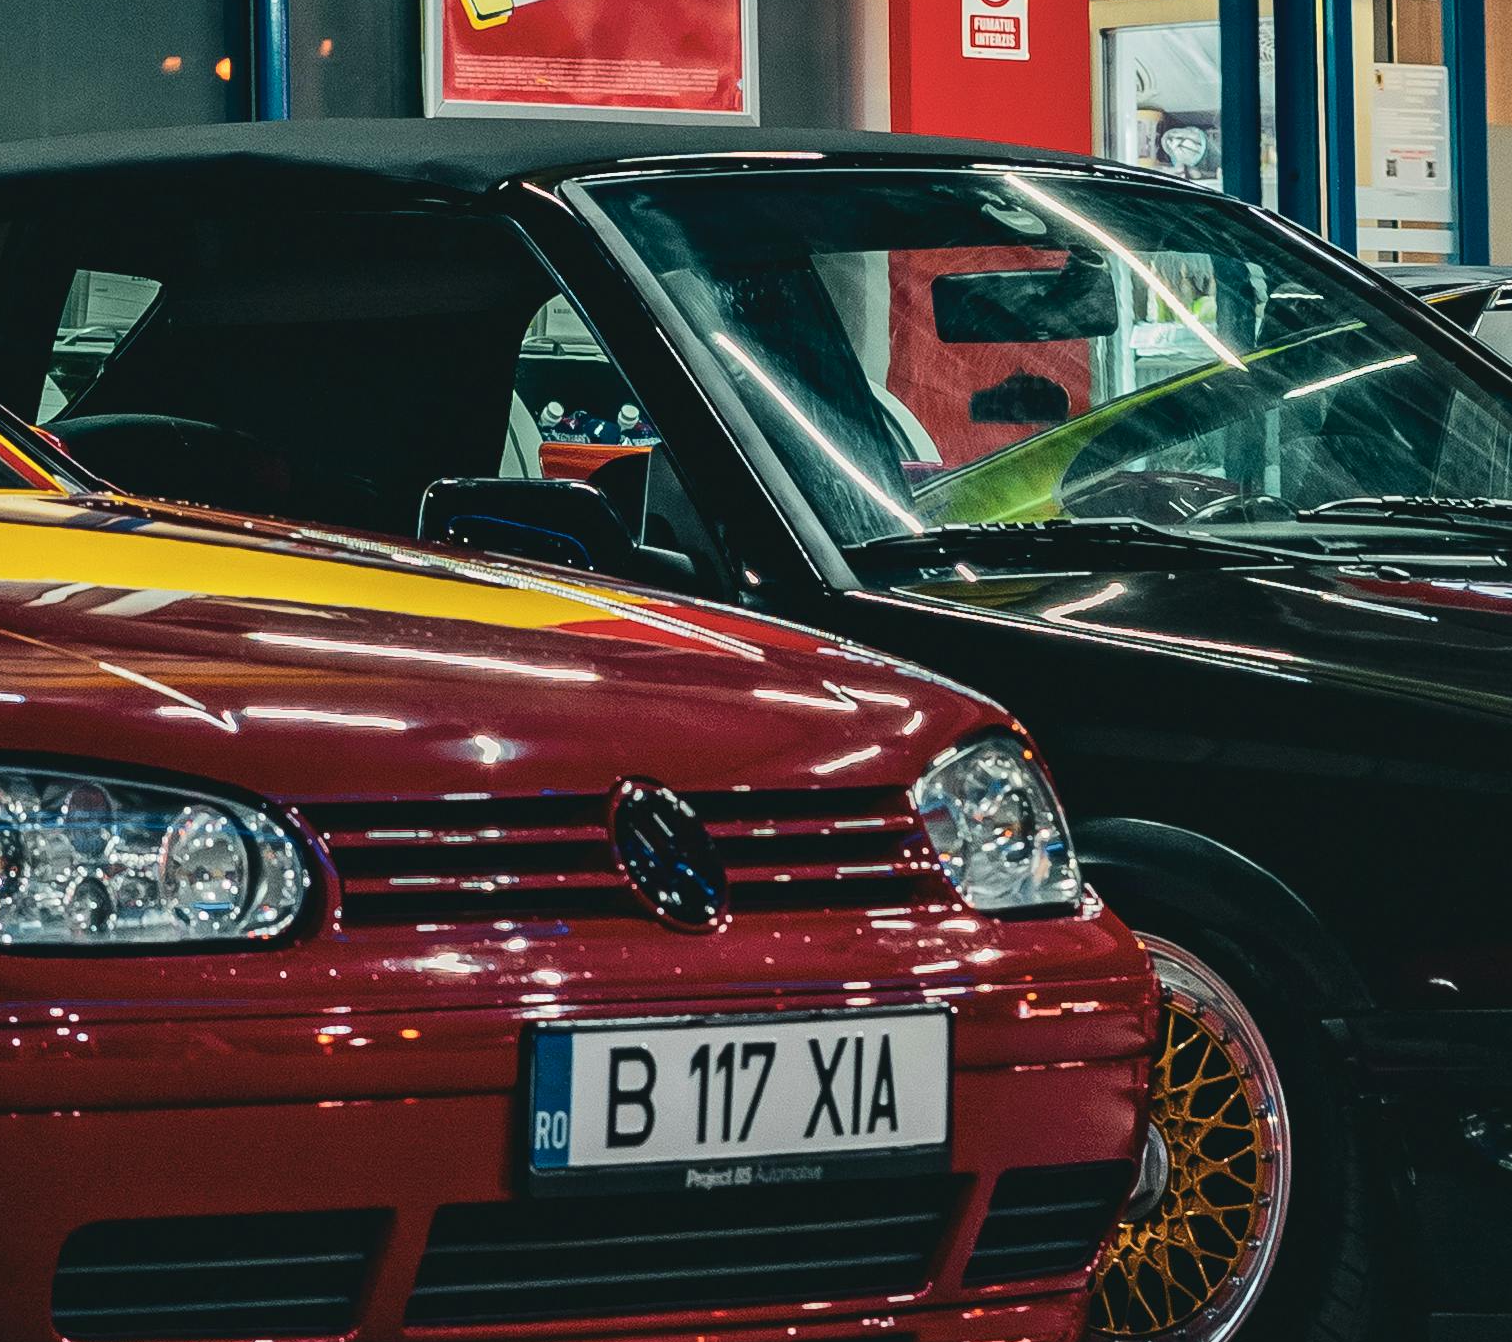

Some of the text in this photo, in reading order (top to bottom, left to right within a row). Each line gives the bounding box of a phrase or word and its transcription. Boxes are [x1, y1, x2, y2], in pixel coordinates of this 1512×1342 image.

[535, 1110, 568, 1150] RO
[606, 1034, 899, 1149] B 117 XIA
